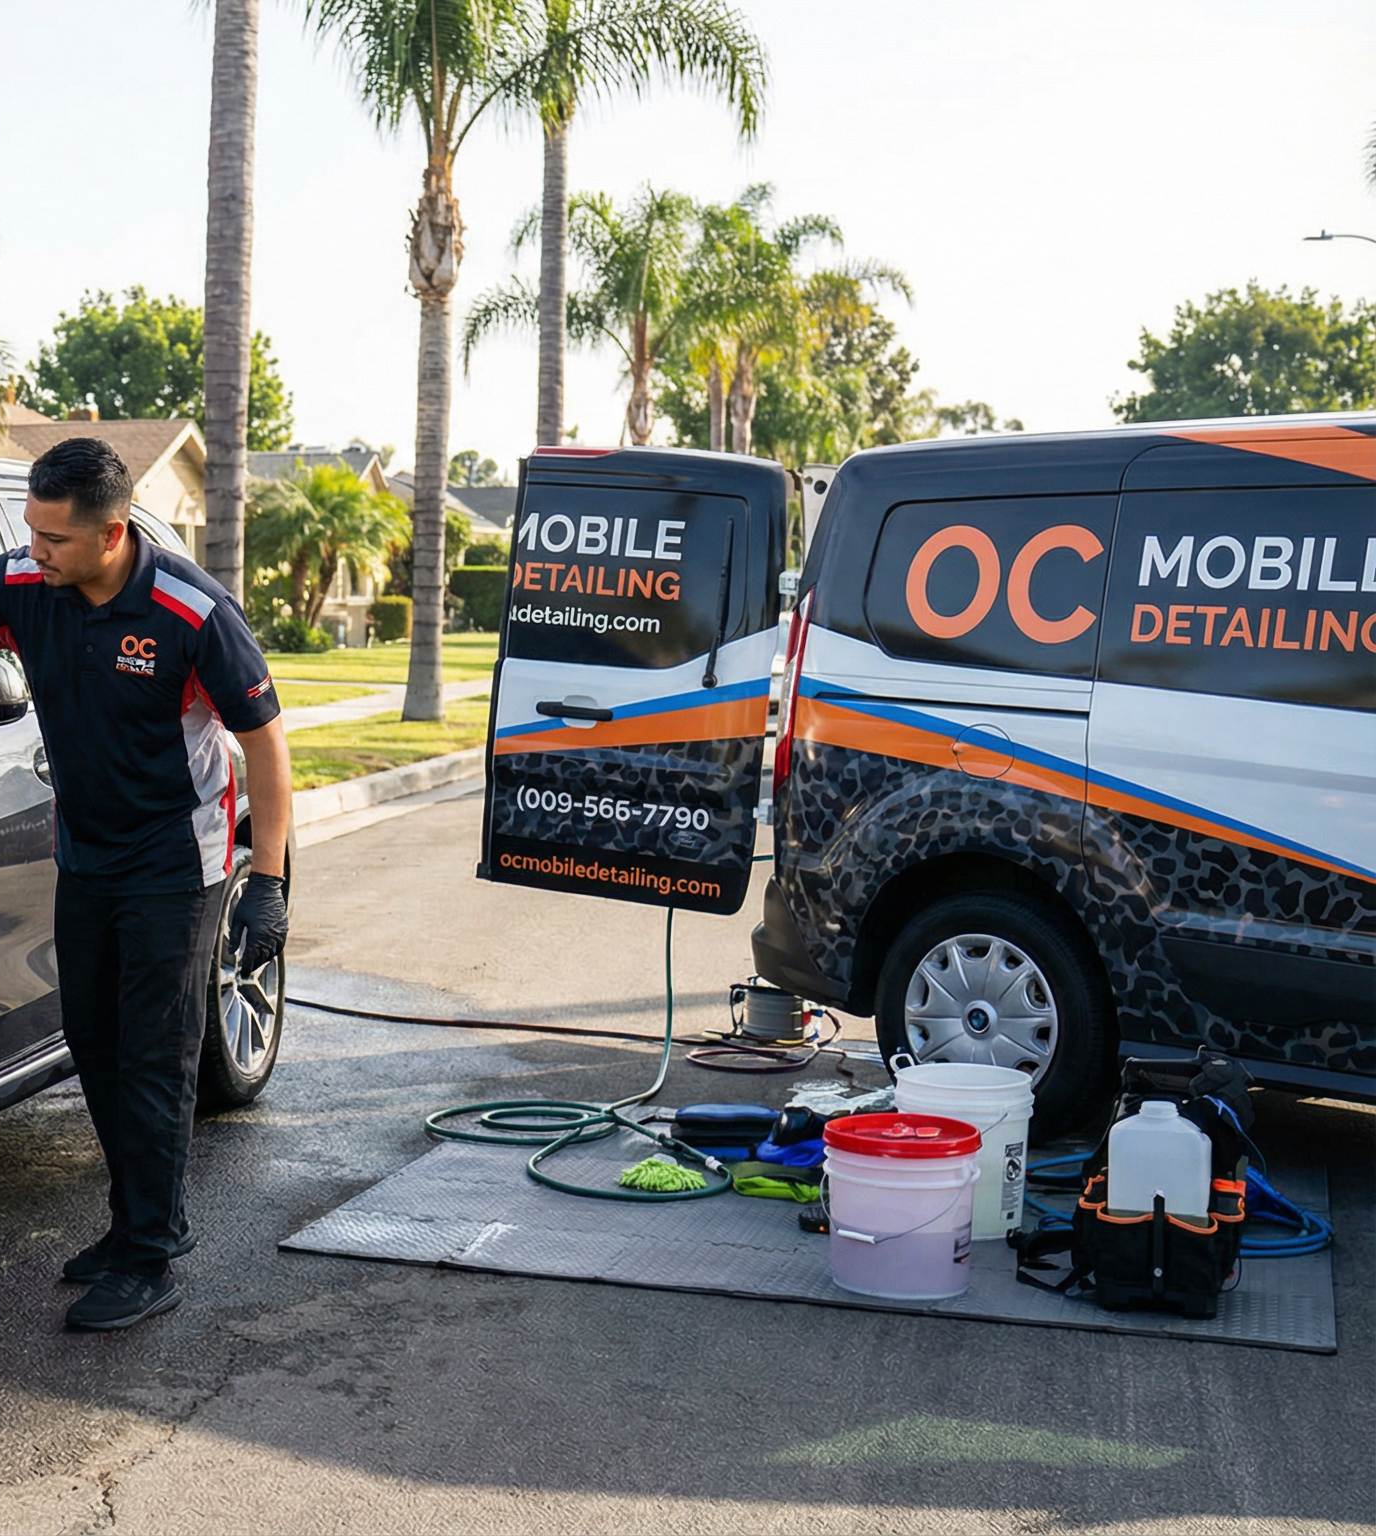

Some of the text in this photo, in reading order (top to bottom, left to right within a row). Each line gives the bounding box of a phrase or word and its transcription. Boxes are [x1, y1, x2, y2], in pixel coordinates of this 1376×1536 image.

[906, 524, 1105, 644] OC
[121, 635, 157, 659] OC
[500, 853, 722, 899] ocmobiledetailing.com
